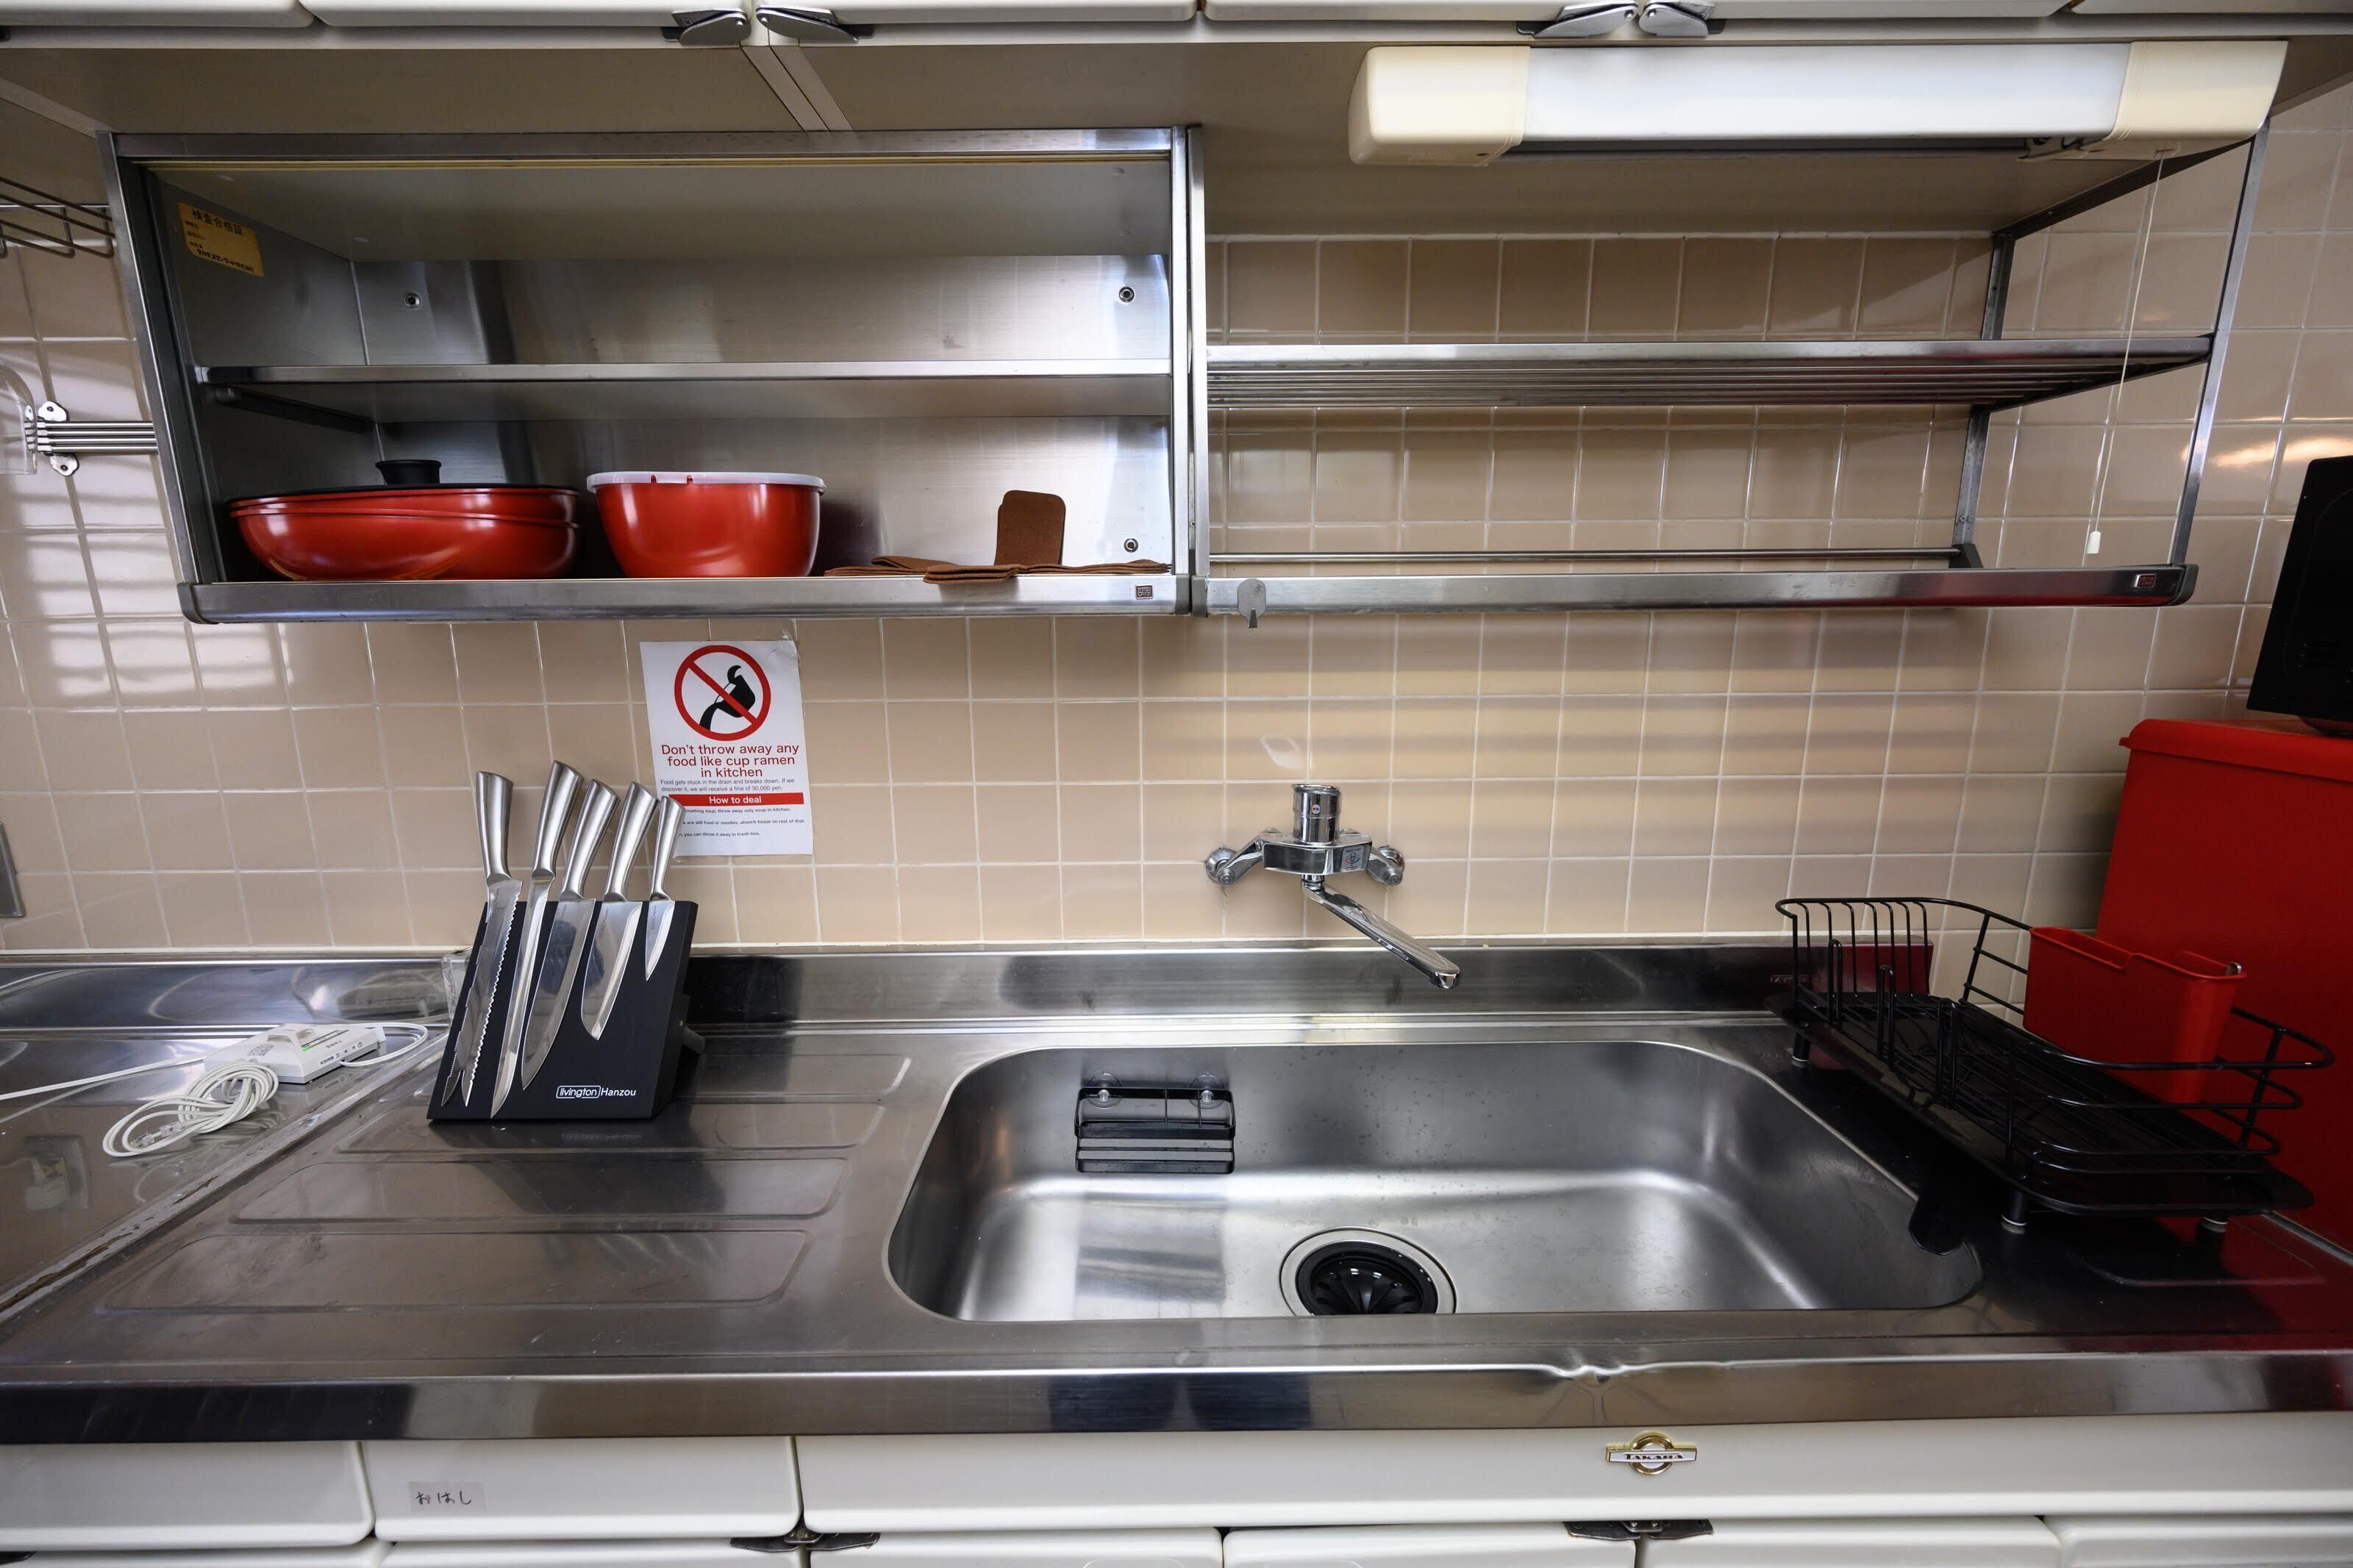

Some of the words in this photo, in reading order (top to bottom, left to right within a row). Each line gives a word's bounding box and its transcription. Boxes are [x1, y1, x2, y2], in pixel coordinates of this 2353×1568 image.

[662, 745, 695, 755] Don't
[698, 745, 735, 754] throw
[740, 745, 772, 756] away
[776, 745, 799, 755] any
[667, 756, 696, 766] food
[700, 756, 722, 766] like
[726, 758, 750, 767] cup
[754, 756, 795, 765] ramen
[701, 767, 712, 777] in
[716, 767, 763, 777] kitchen
[743, 795, 762, 803] deal
[560, 1087, 597, 1098] livington
[601, 1087, 637, 1096] Hanzou
[415, 1490, 472, 1506] おはし
